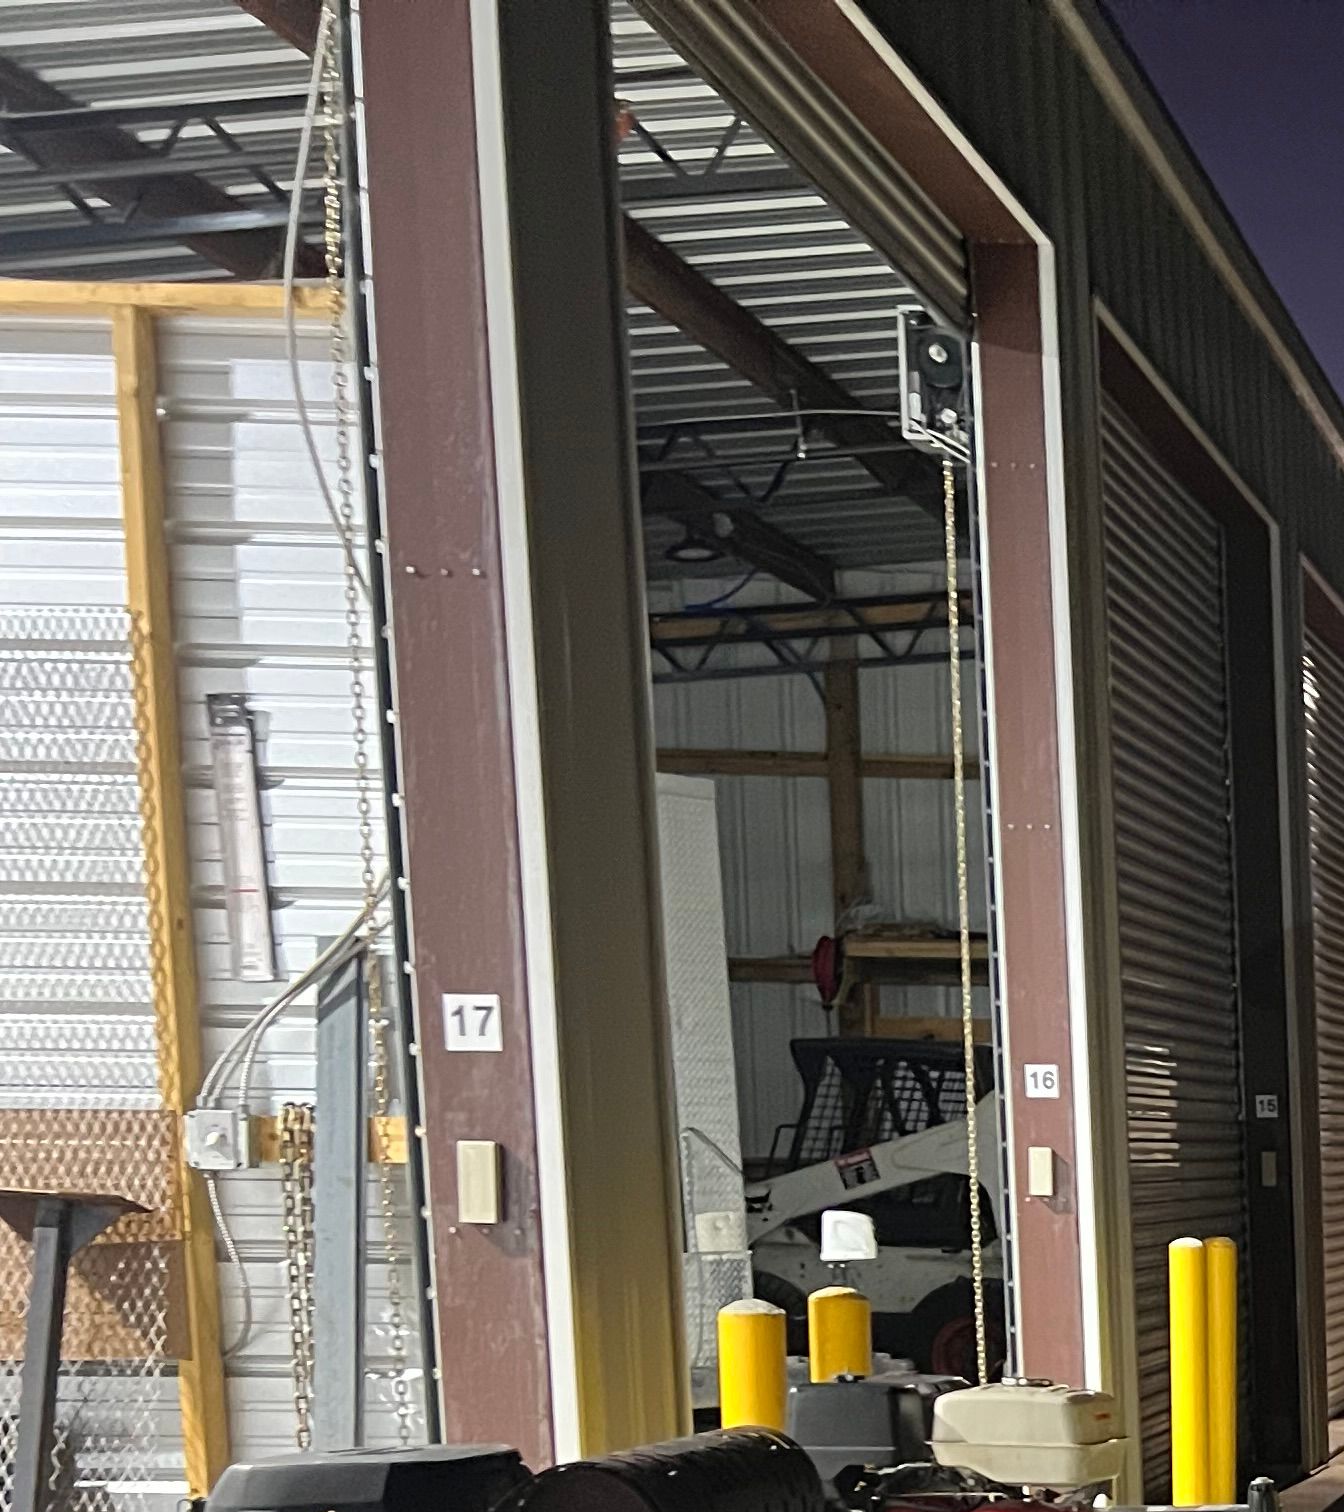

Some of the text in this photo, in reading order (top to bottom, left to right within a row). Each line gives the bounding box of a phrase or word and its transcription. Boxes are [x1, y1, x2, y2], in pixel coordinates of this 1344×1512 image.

[451, 1005, 494, 1036] 17
[1030, 1071, 1055, 1090] 16
[1258, 1099, 1276, 1112] 15
